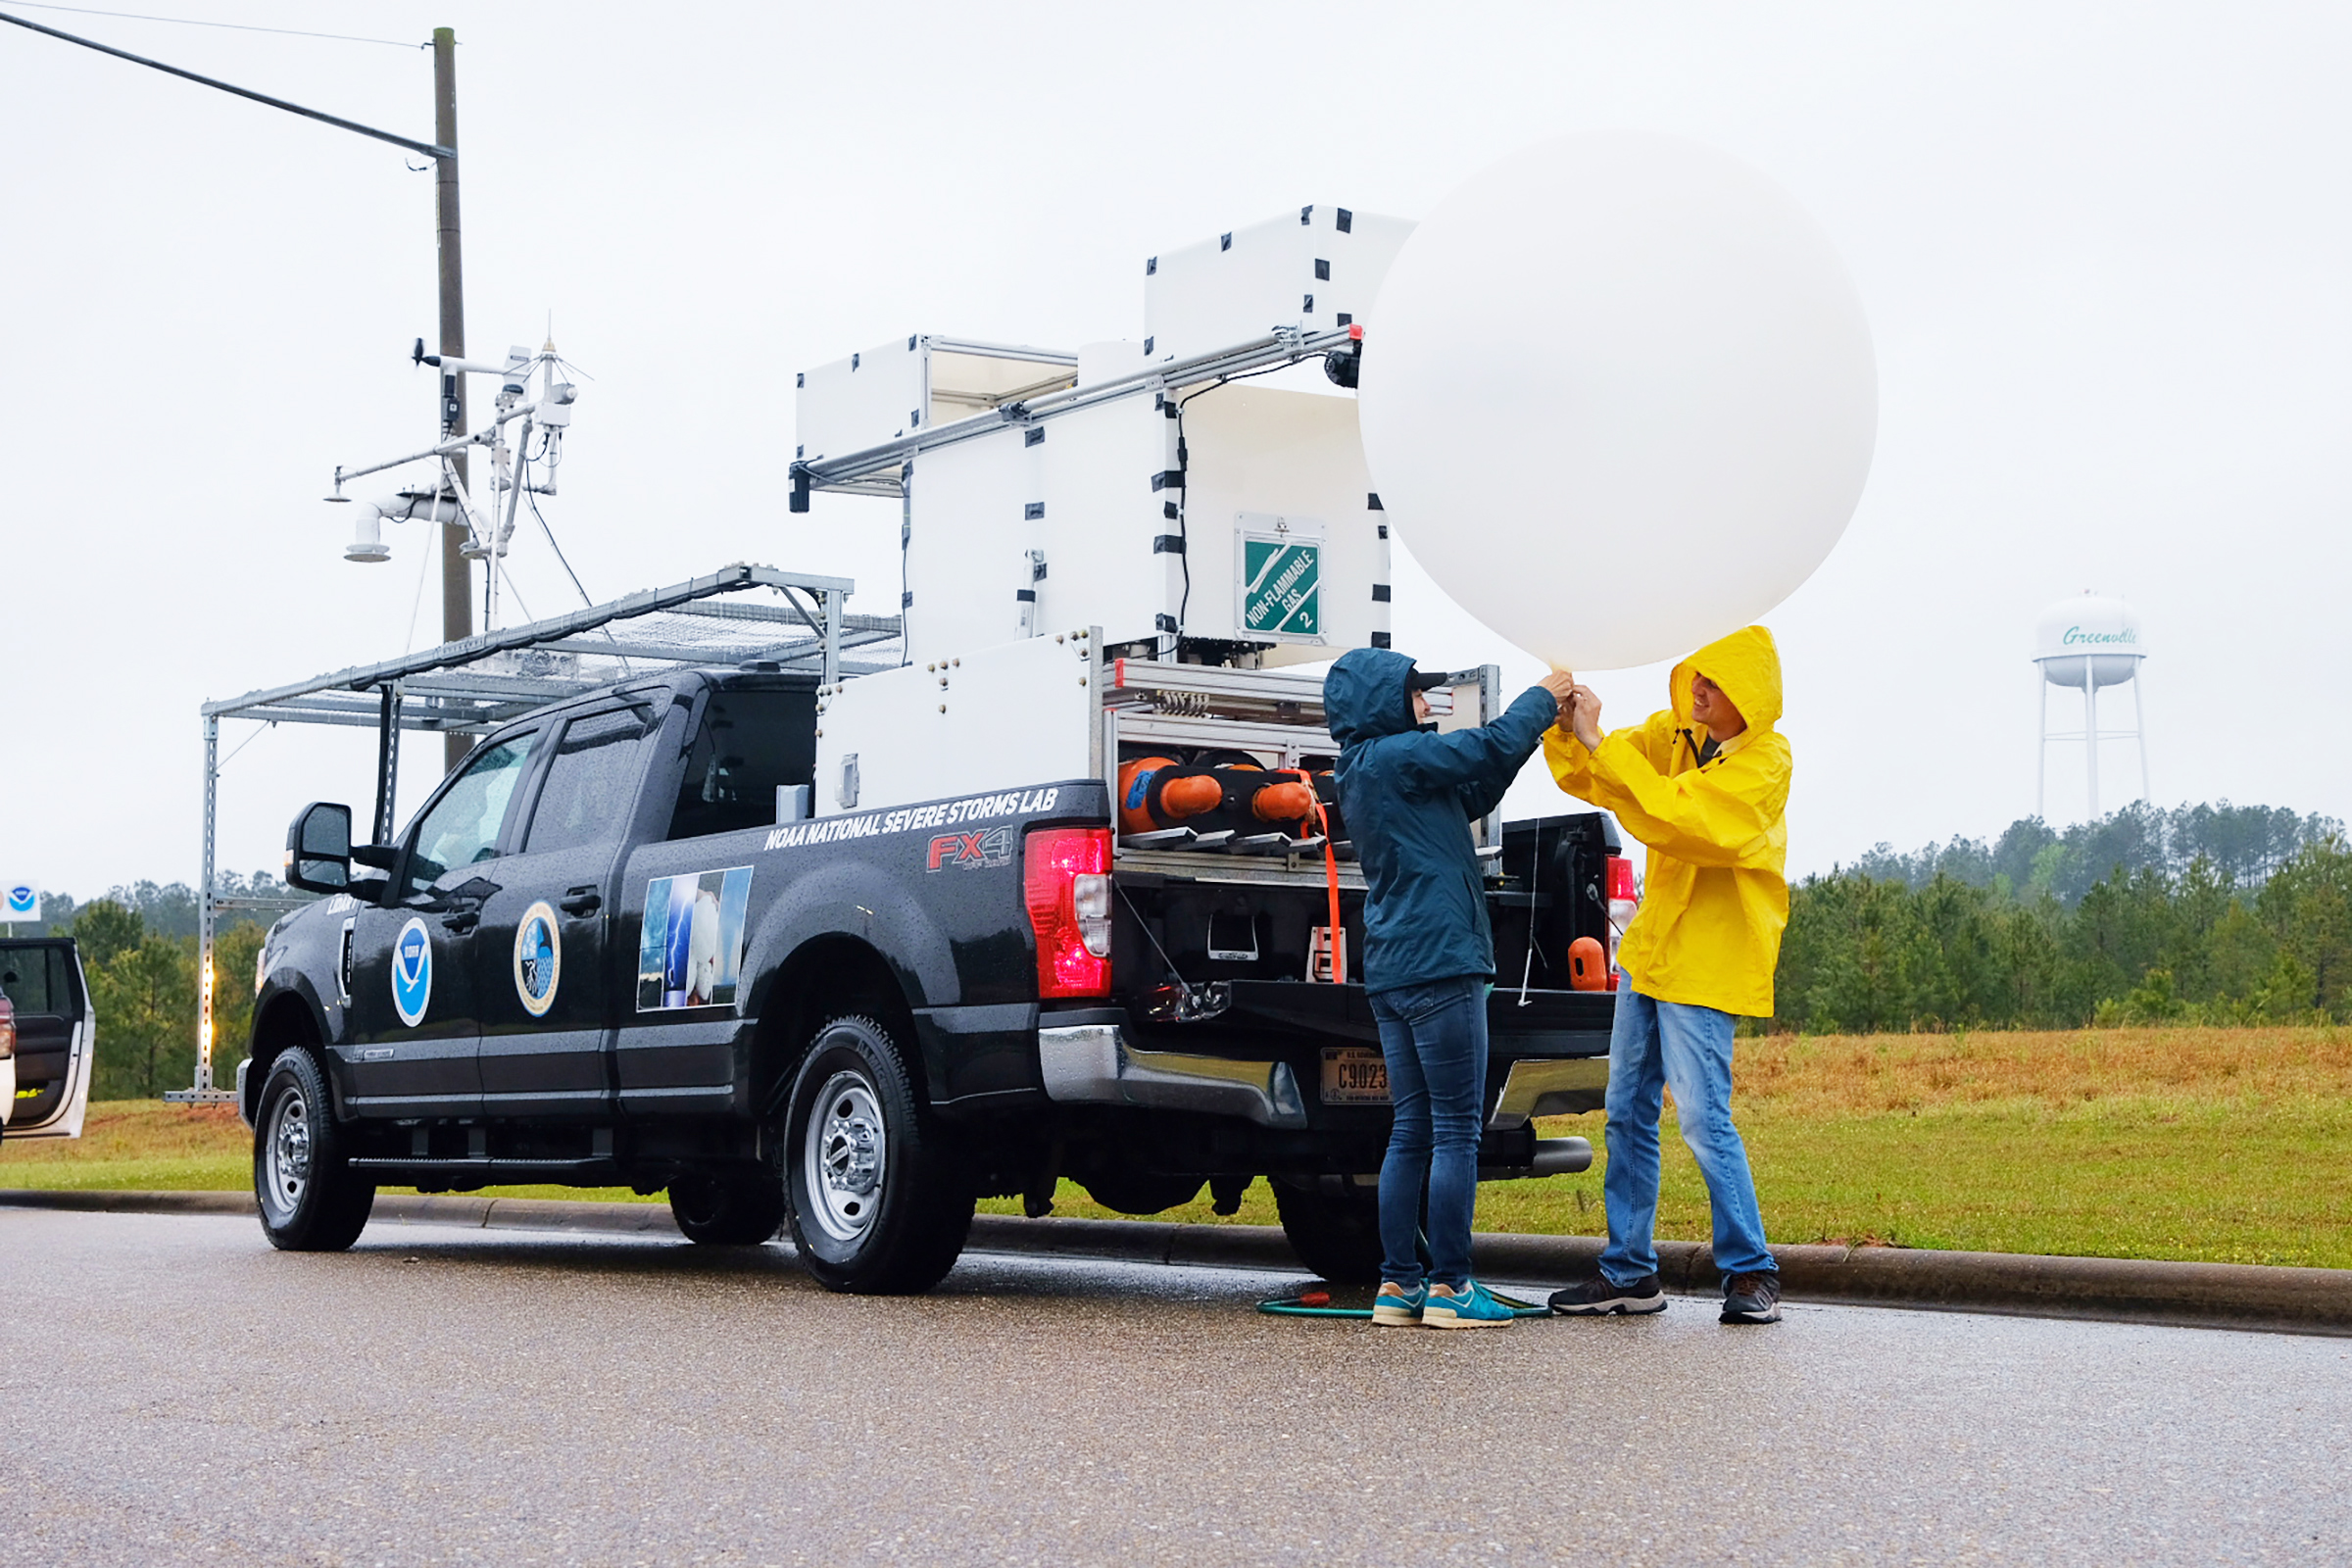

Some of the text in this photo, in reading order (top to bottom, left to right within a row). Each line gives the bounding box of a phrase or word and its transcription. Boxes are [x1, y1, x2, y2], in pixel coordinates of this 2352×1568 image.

[1246, 550, 1314, 627] NON-FLAMMABLE
[1281, 588, 1302, 612] GAS
[1299, 612, 1314, 628] 2
[763, 788, 1058, 851] NOAA NATIONAL SEVERE STORMS LAB
[926, 824, 1013, 873] FX4
[1339, 1063, 1388, 1089] C9023
